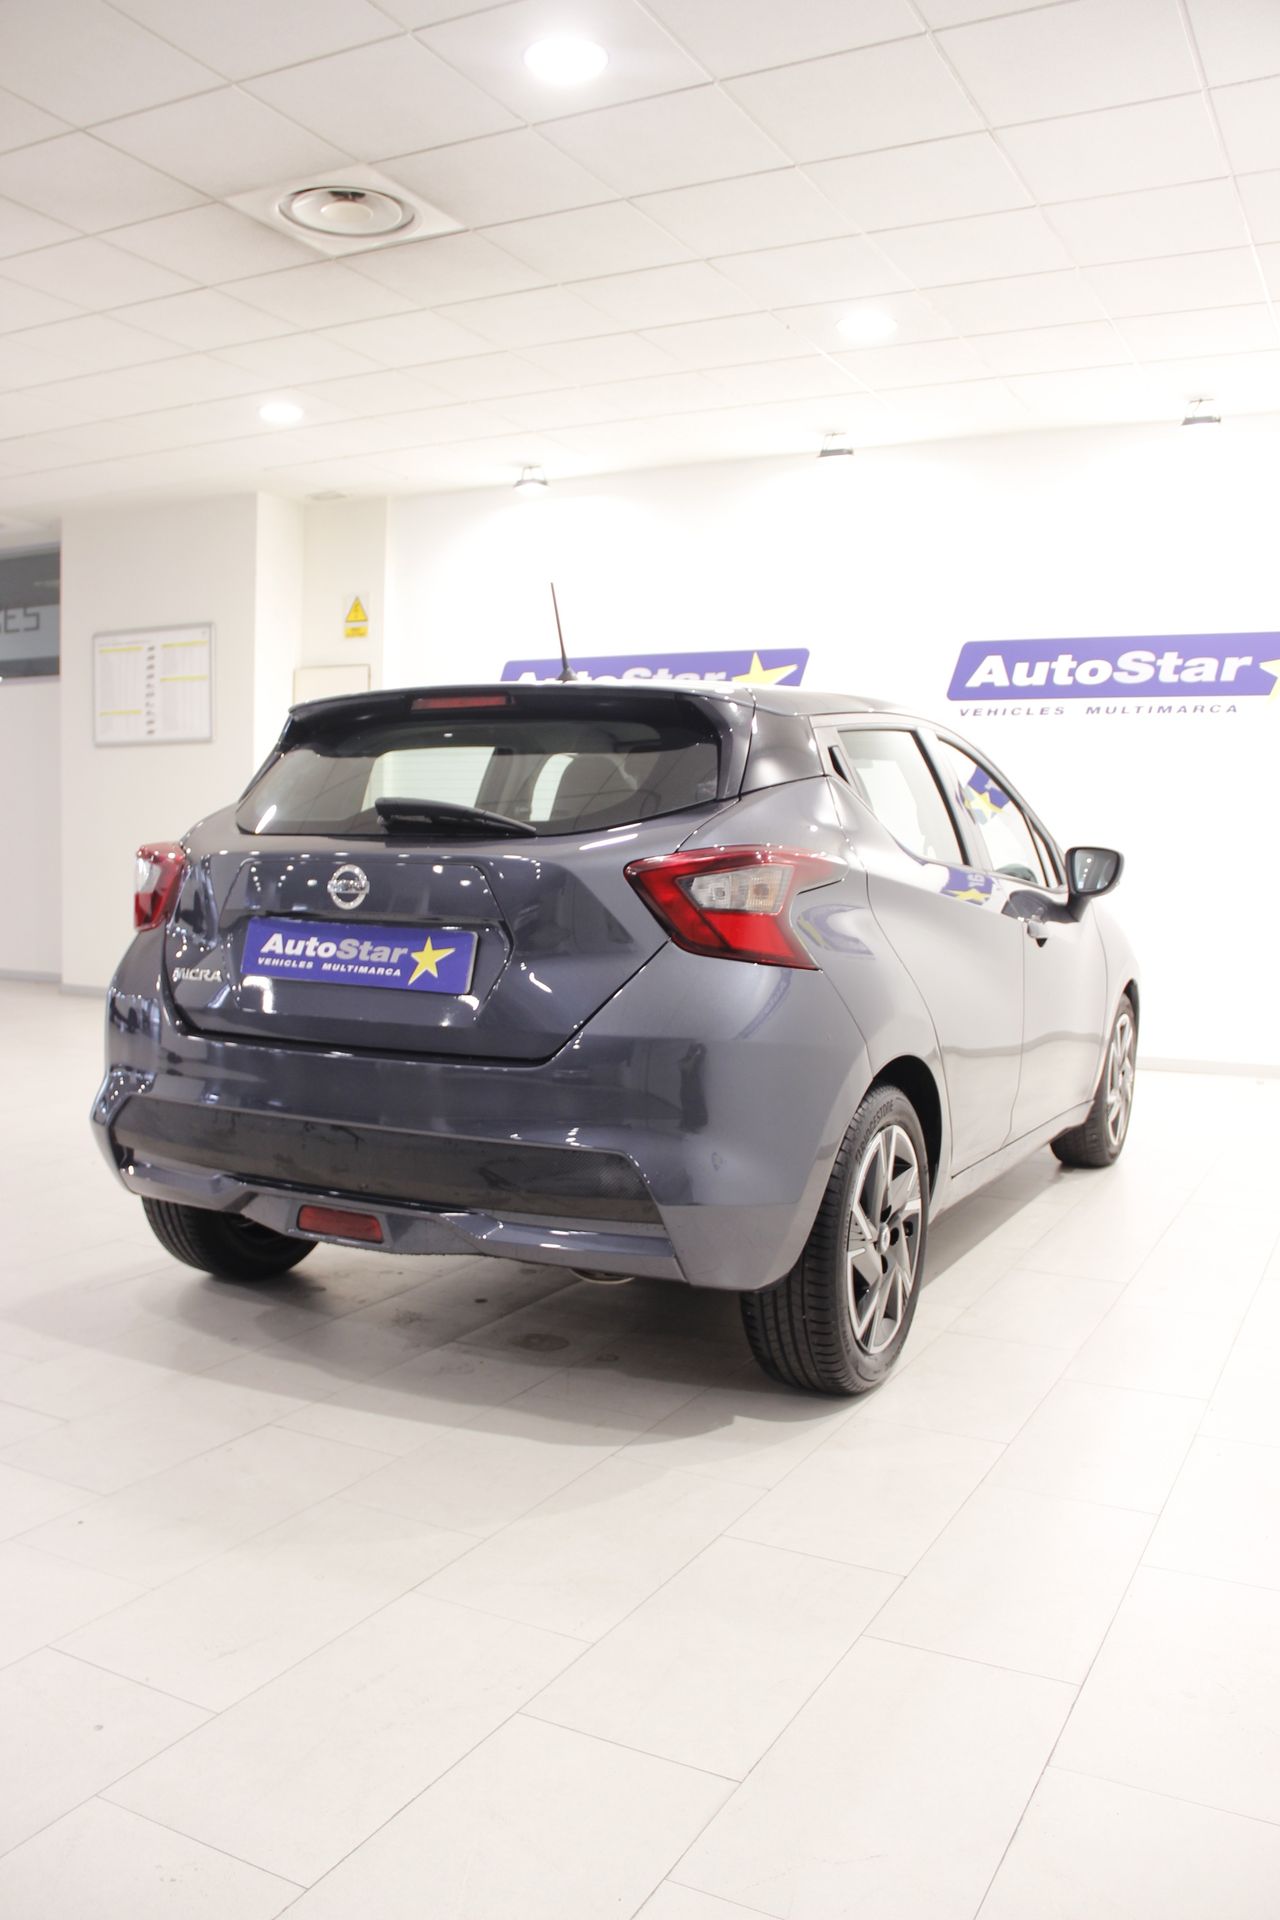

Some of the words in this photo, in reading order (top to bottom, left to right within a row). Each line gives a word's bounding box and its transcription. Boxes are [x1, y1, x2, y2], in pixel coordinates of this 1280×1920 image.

[0, 607, 40, 633] ES
[965, 650, 1253, 688] AutoStar
[960, 706, 1065, 717] VEHICLES
[1086, 704, 1238, 715] MULTIMARCA
[260, 932, 408, 964] AutoStar
[172, 967, 222, 982] MICRA
[257, 957, 313, 970] VEHICLES
[321, 962, 401, 977] MULTIMARCA
